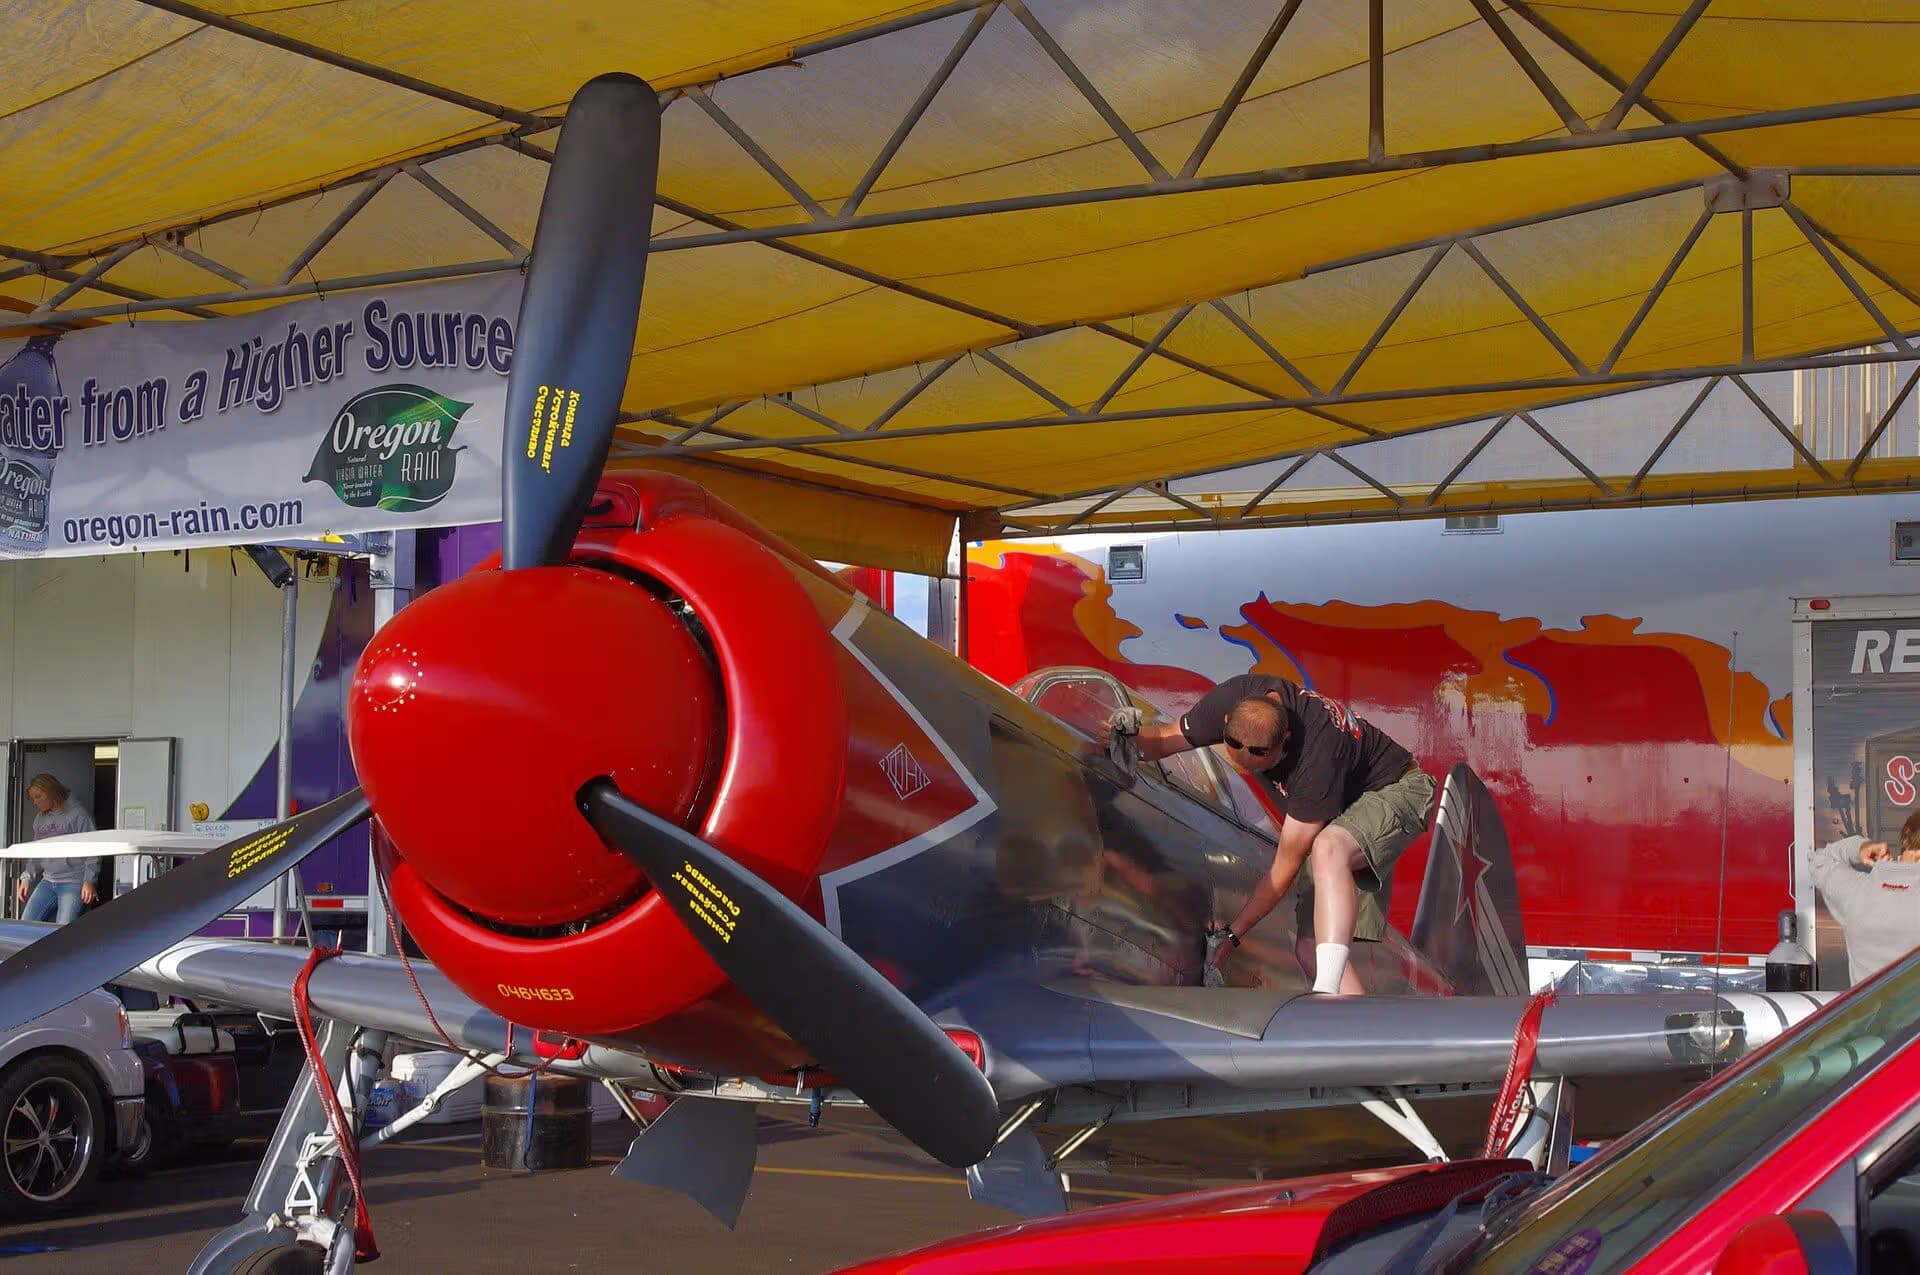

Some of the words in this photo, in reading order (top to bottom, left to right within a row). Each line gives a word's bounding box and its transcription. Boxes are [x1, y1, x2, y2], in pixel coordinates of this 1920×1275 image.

[80, 376, 169, 447] from
[177, 368, 209, 423] a
[217, 321, 354, 413] Higher
[363, 298, 515, 376] Source
[333, 412, 442, 461] Oregon
[357, 464, 383, 479] WATER
[401, 450, 441, 482] RAIN
[63, 499, 304, 547] oregon-rain.com
[1851, 629, 1920, 674] RE
[1885, 755, 1920, 806] S
[497, 983, 575, 1001] 0464633
